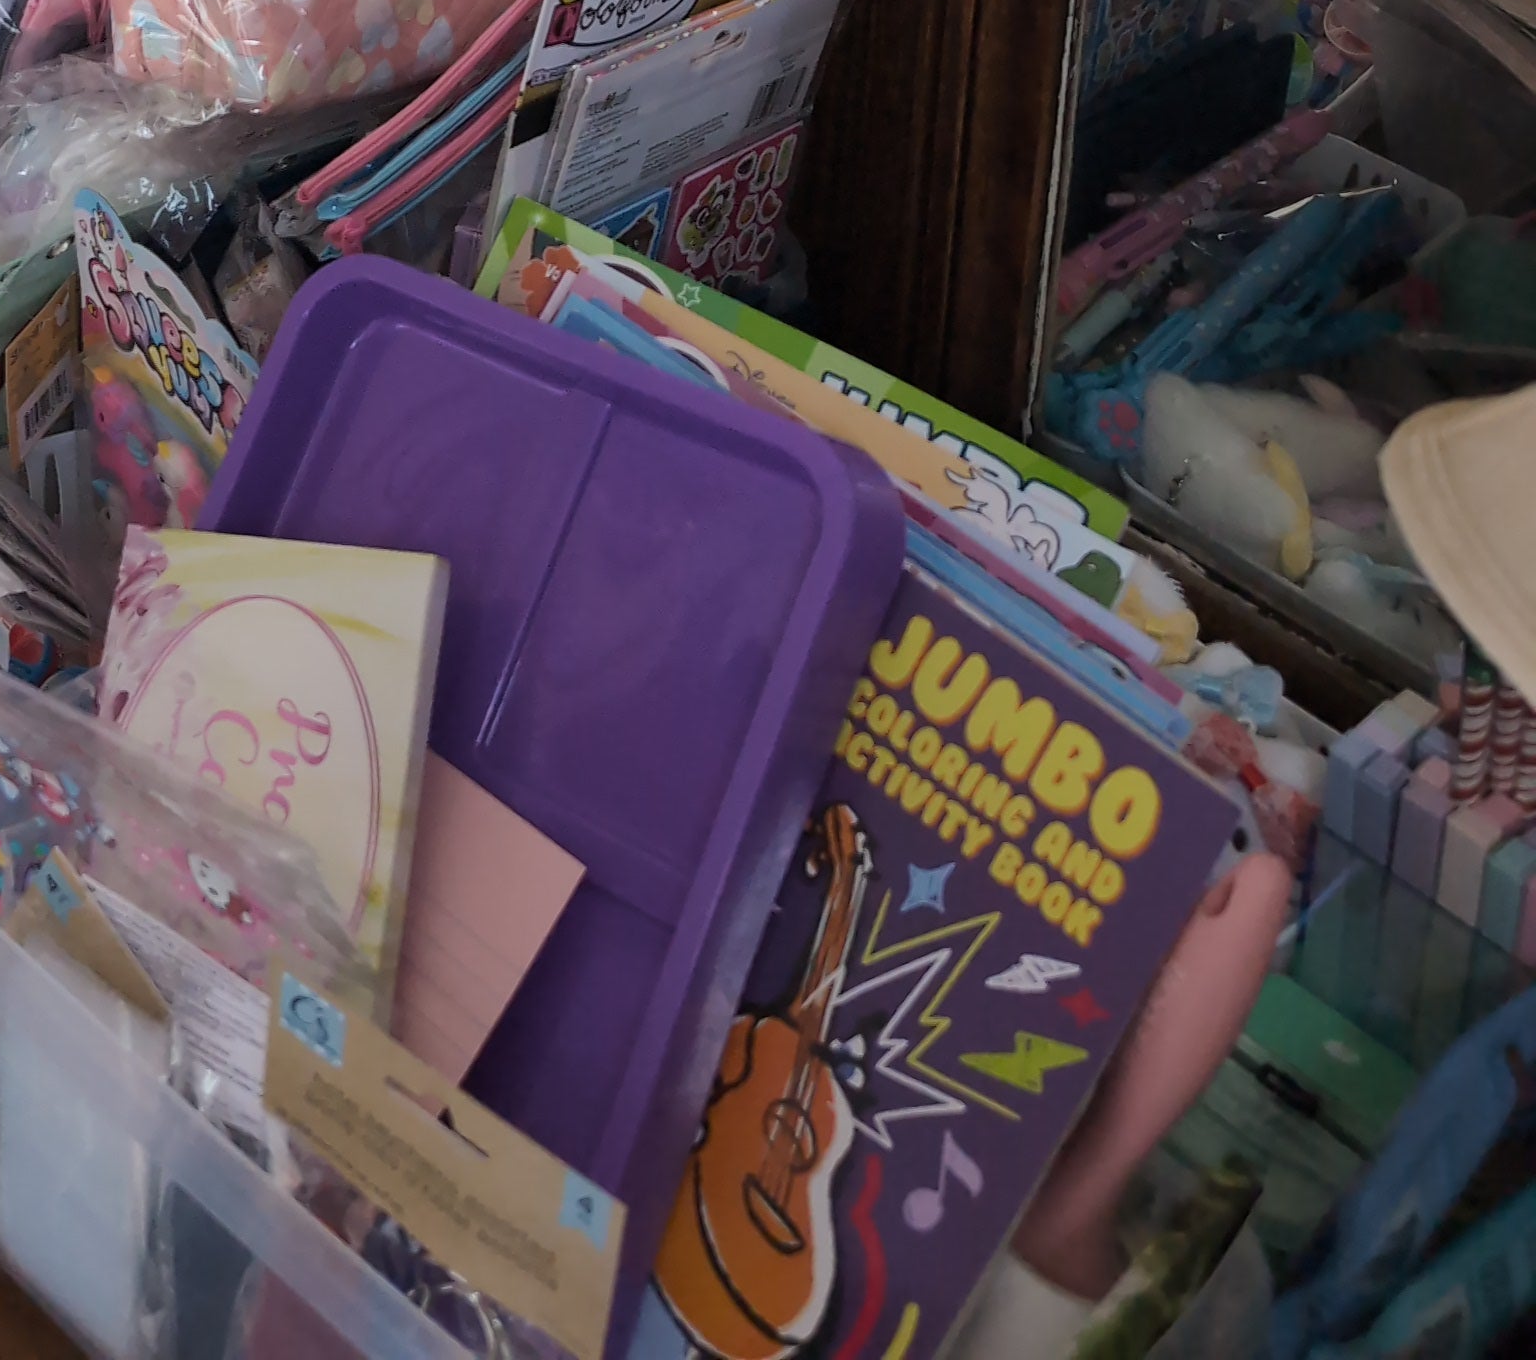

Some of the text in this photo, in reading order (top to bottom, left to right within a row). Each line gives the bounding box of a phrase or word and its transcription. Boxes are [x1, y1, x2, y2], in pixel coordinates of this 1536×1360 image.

[848, 678, 1127, 904] COLORING AND
[869, 614, 1162, 861] JUMBO
[988, 842, 1104, 948] BOOK
